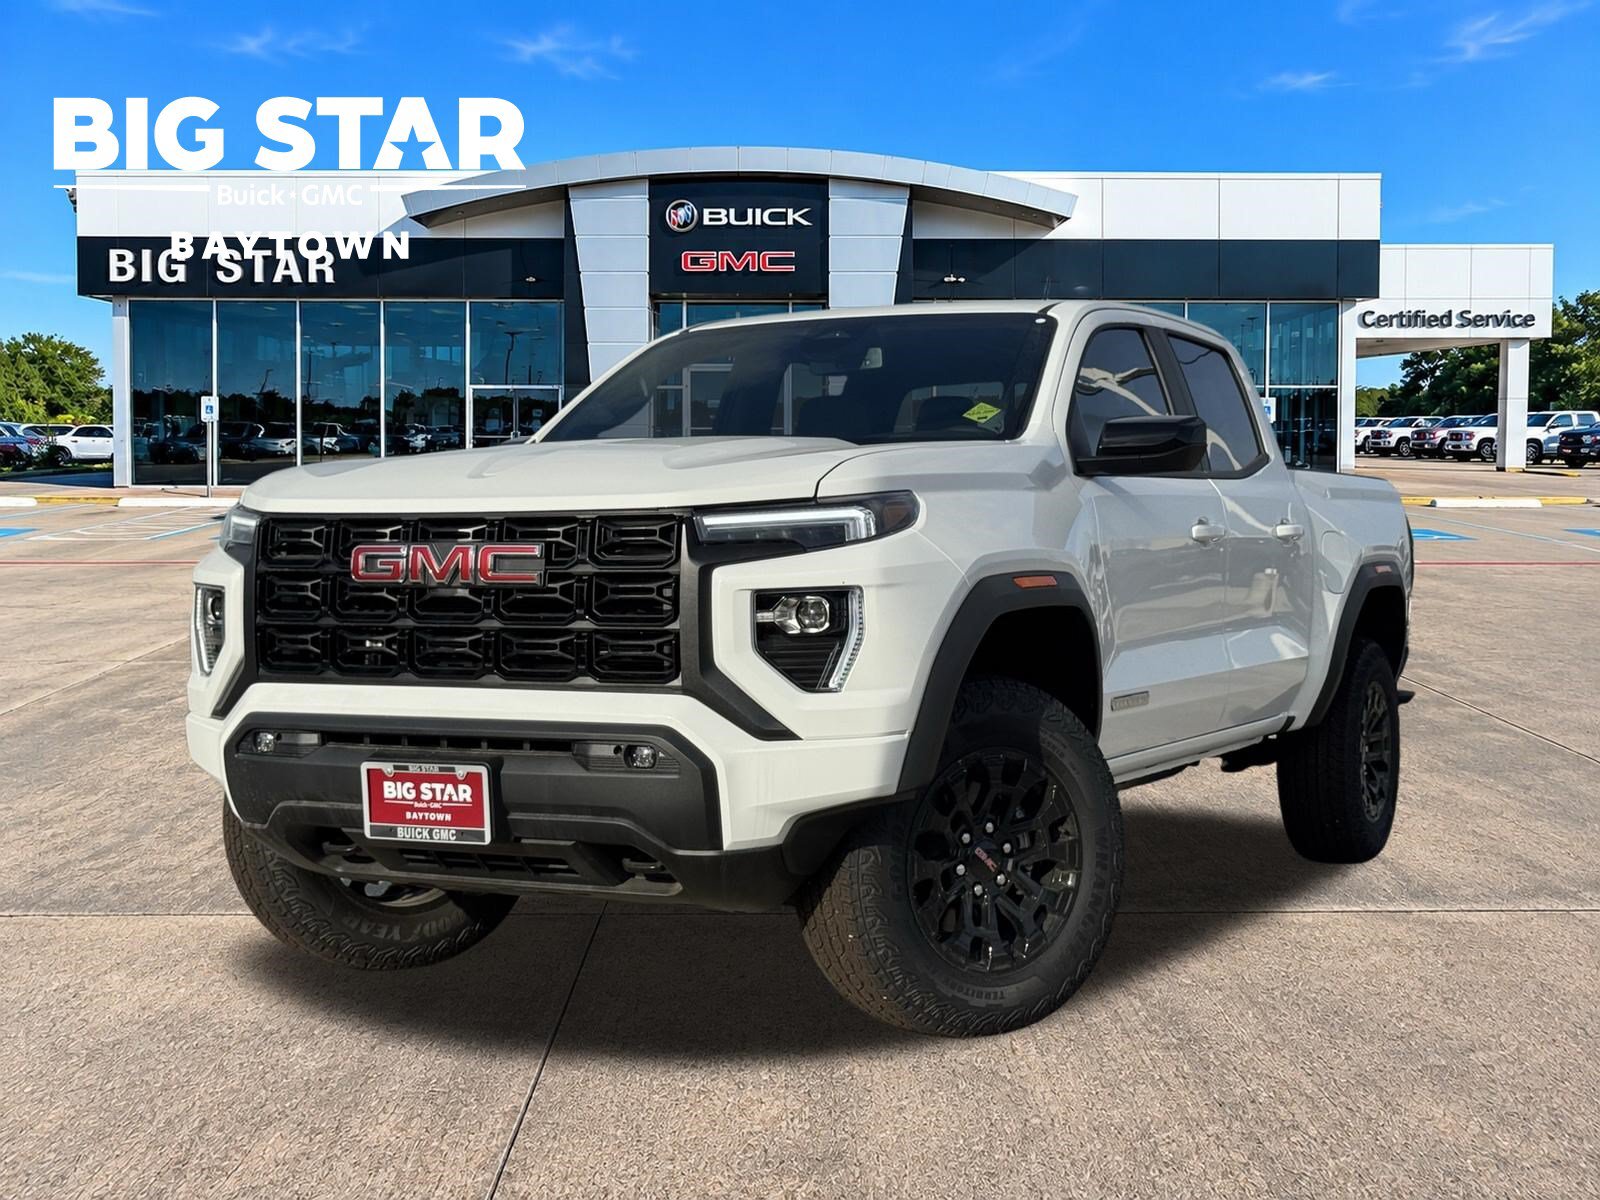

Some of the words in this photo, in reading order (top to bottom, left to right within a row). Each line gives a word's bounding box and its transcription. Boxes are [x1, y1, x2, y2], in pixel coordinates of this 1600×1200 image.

[702, 207, 813, 226] BUICK
[108, 249, 187, 283] BIG
[215, 249, 336, 284] STAR
[681, 251, 796, 272] GMC
[1359, 310, 1453, 328] Certified
[1455, 310, 1536, 329] Service
[351, 544, 544, 585] GMC
[383, 781, 417, 800] BIG
[420, 783, 473, 802] STAR
[405, 811, 452, 822] BAYTOWN
[397, 827, 430, 839] BUICK
[432, 829, 457, 841] GMC
